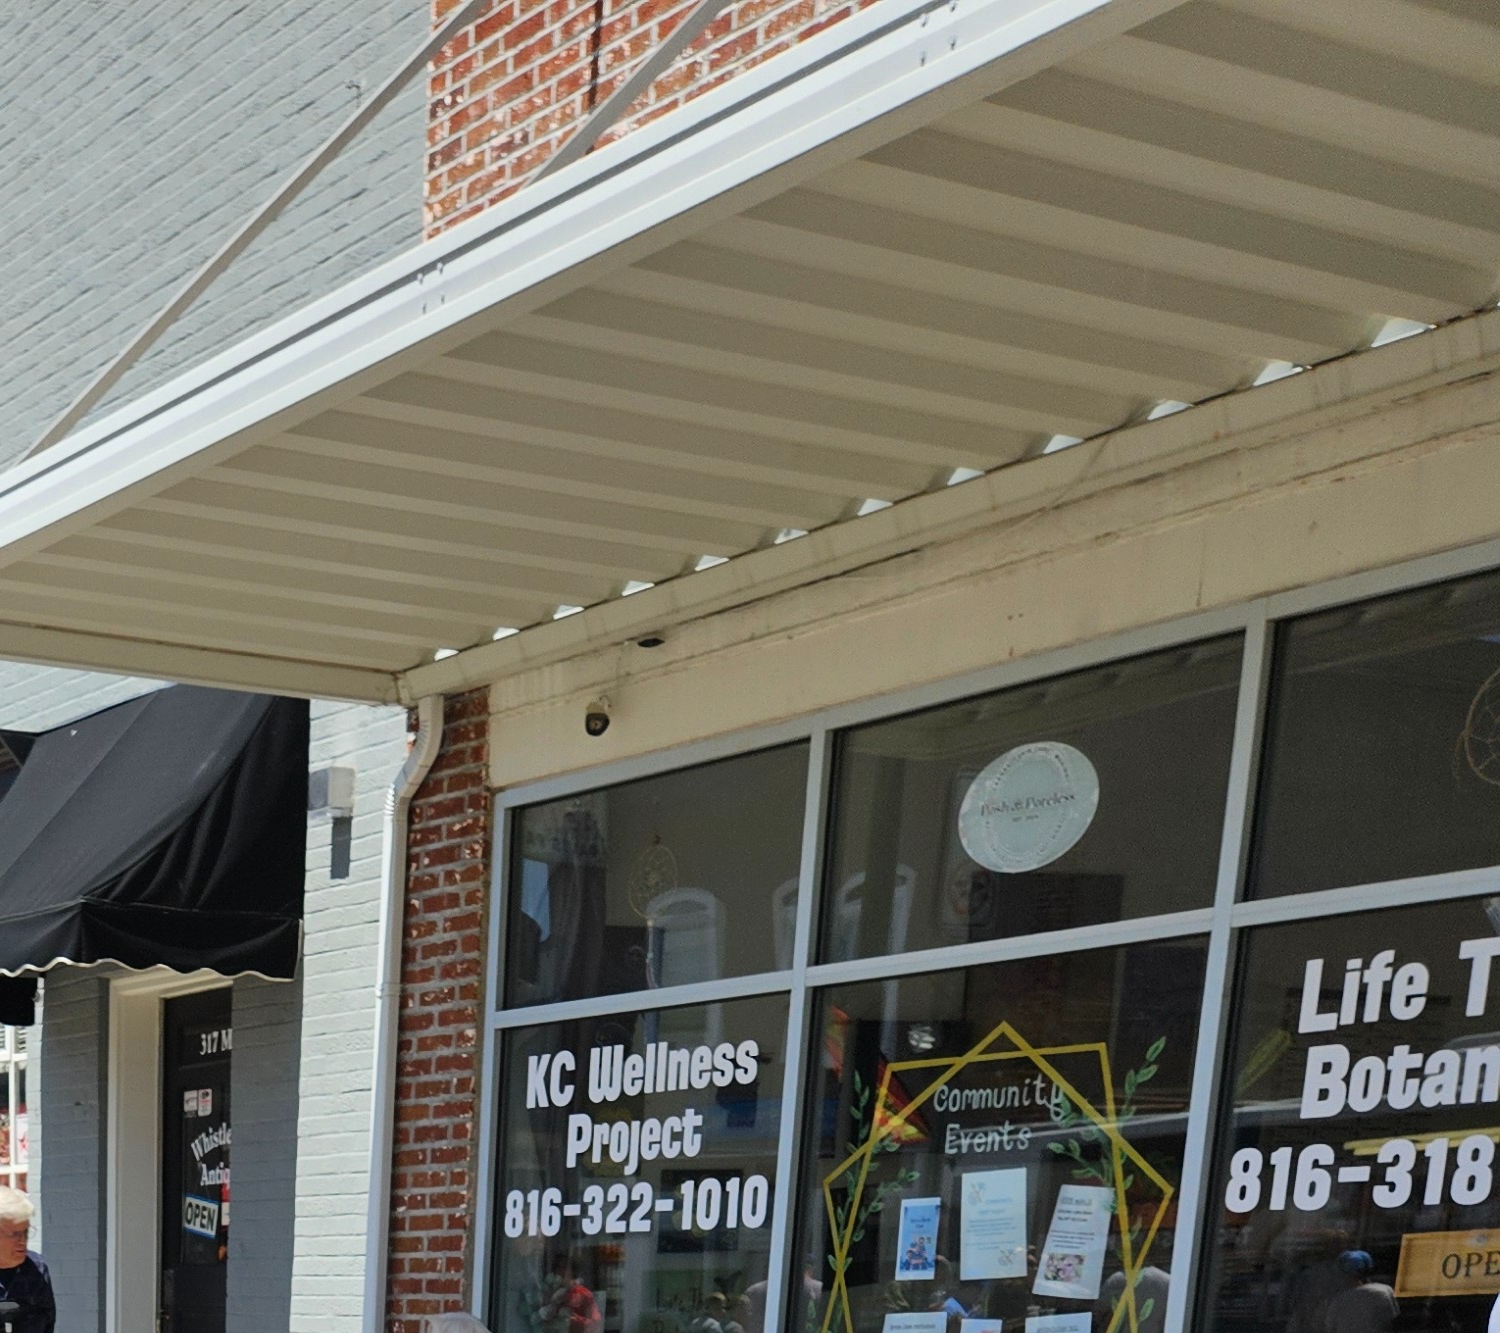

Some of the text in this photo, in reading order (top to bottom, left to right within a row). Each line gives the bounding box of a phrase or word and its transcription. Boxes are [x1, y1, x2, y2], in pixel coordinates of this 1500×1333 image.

[1298, 949, 1431, 1034] Life
[199, 1031, 219, 1055] 317
[526, 1039, 760, 1109] KC Wellness
[933, 1073, 1065, 1122] Community
[566, 1108, 703, 1176] Project
[945, 1120, 1033, 1155] Events
[185, 1203, 216, 1231] OPEN
[504, 1174, 769, 1238] 816-322-1010
